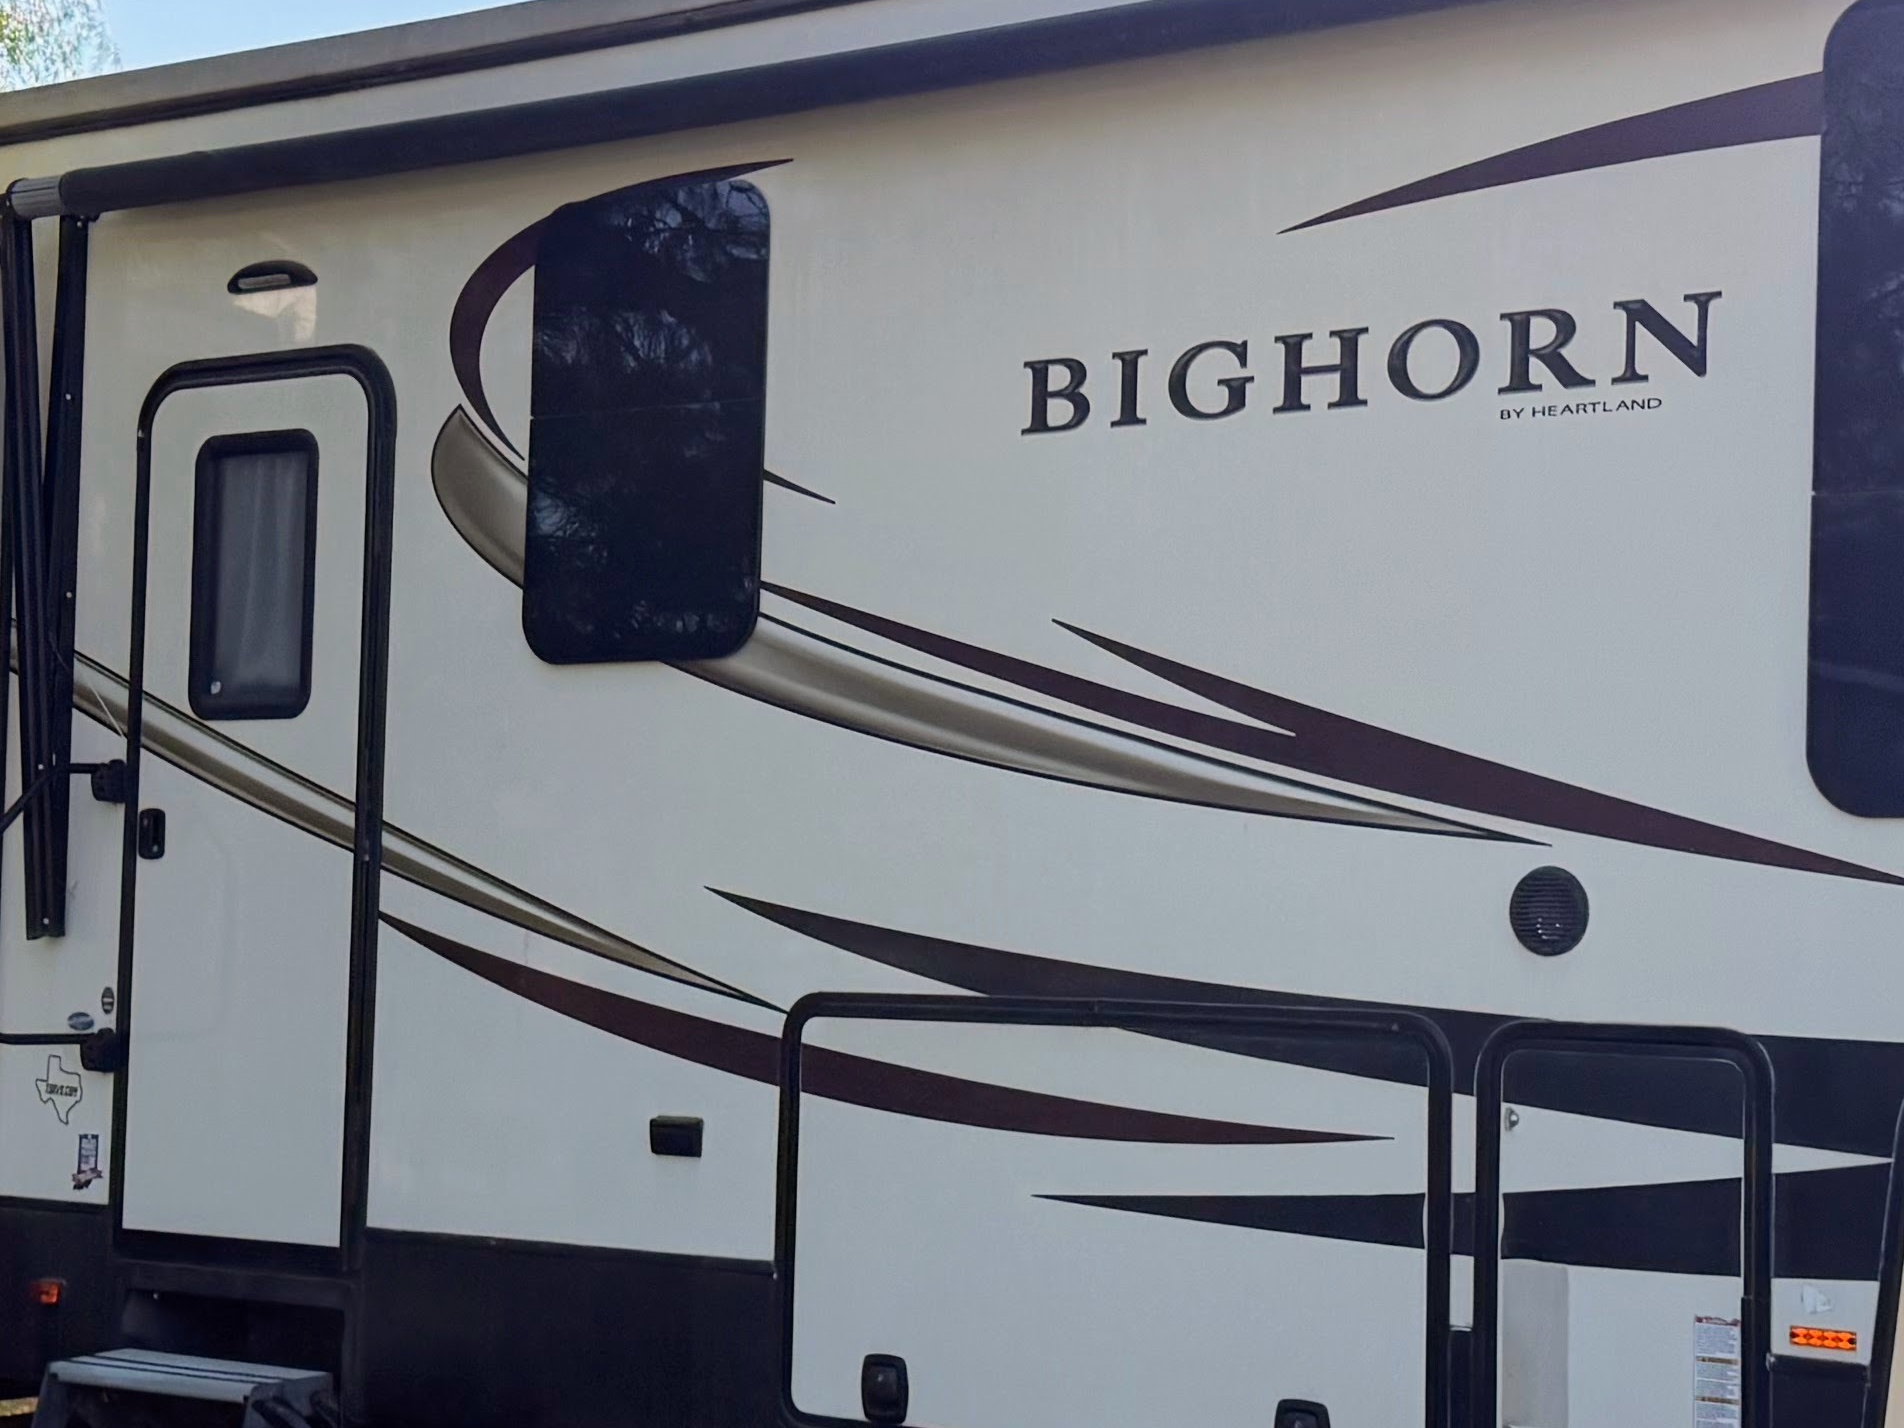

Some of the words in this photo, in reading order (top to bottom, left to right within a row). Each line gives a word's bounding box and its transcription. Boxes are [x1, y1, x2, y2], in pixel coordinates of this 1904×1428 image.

[1020, 290, 1723, 436] BIGHORN
[1499, 407, 1525, 421] BY
[1531, 397, 1663, 418] HEARTLAND
